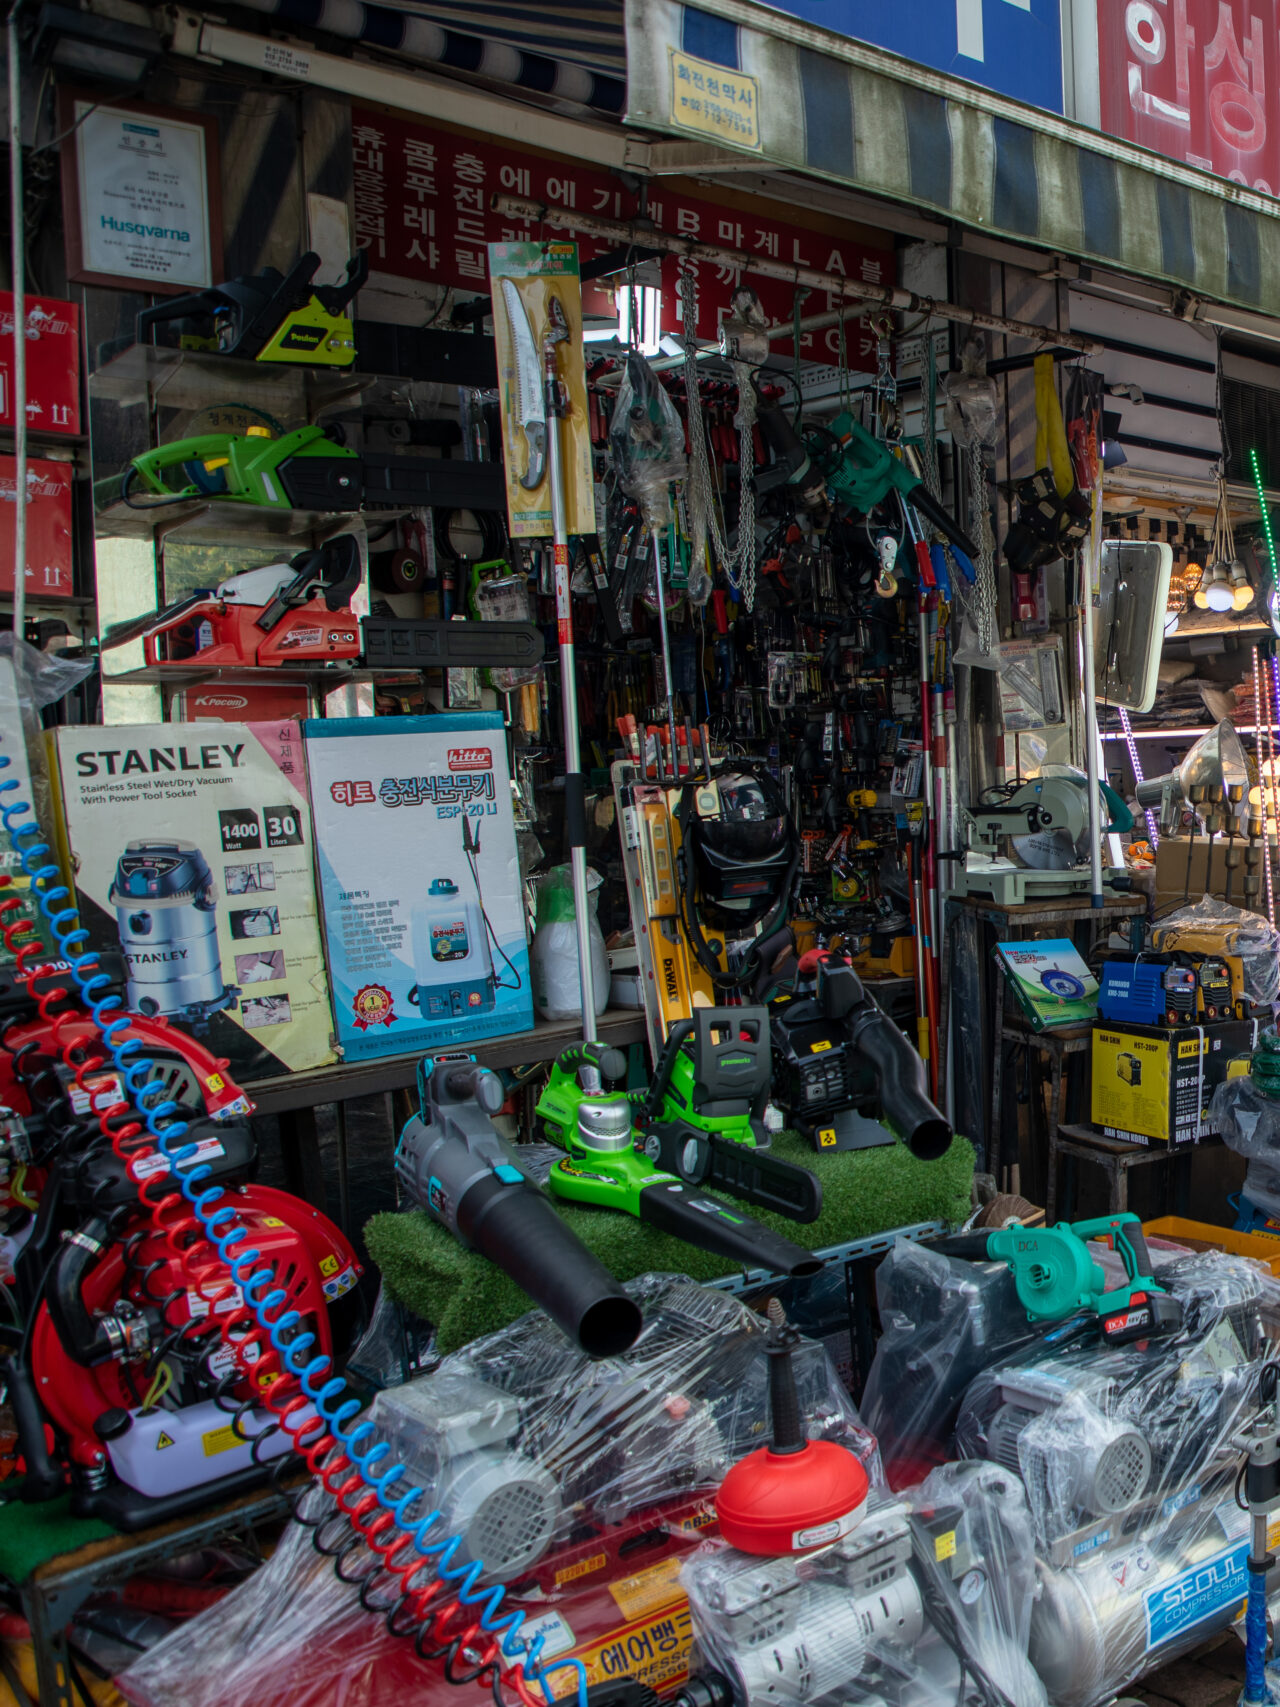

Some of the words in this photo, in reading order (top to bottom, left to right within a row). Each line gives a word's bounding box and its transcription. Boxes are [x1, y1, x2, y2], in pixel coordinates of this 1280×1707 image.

[352, 125, 387, 259] 휴대용용접기
[403, 137, 440, 271] 콤푸레샤
[101, 215, 190, 242] Husqvarna
[453, 153, 487, 280] 충전드릴
[75, 744, 245, 777] STANLEY
[278, 728, 297, 775] 신제품
[80, 782, 125, 794] Stainless
[127, 780, 151, 791] Steel
[153, 778, 193, 791] Wet/Dry
[195, 776, 233, 786] Vacuum
[81, 794, 106, 806] With
[109, 793, 142, 804] Power
[143, 791, 164, 801] Tool
[165, 789, 198, 800] Socket
[331, 780, 376, 806] 히토
[379, 772, 496, 808] 충전식분무기
[222, 822, 259, 840] 1400
[268, 816, 297, 837] 30
[225, 841, 243, 850] Watt
[270, 838, 288, 847] Liters
[126, 950, 188, 965] STANLEY
[663, 957, 679, 1003] DEWALT
[1018, 1240, 1039, 1252] DCA
[1108, 1318, 1124, 1330] DCA
[1163, 1557, 1245, 1613] SEOUL
[1165, 1573, 1246, 1624] COMPRESSOR
